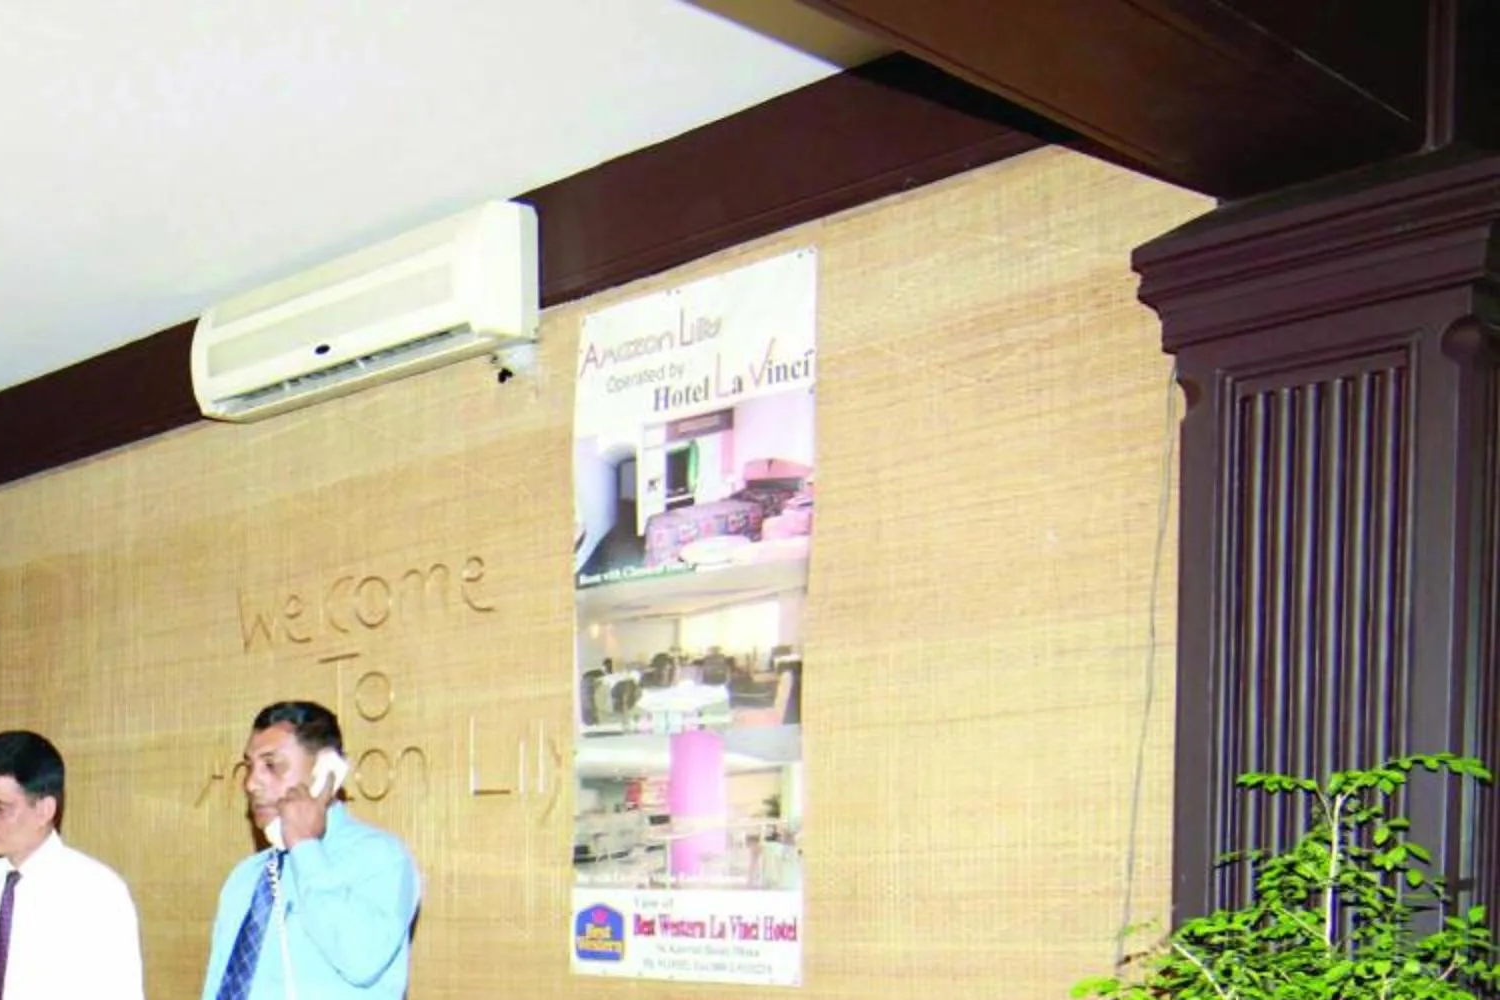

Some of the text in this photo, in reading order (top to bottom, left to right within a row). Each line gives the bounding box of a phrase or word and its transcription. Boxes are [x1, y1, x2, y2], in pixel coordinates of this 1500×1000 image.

[652, 375, 710, 412] Hotel
[714, 351, 744, 398] La
[237, 556, 496, 654] Welcome
[633, 913, 798, 943] Best Western La Vinci Hotel
